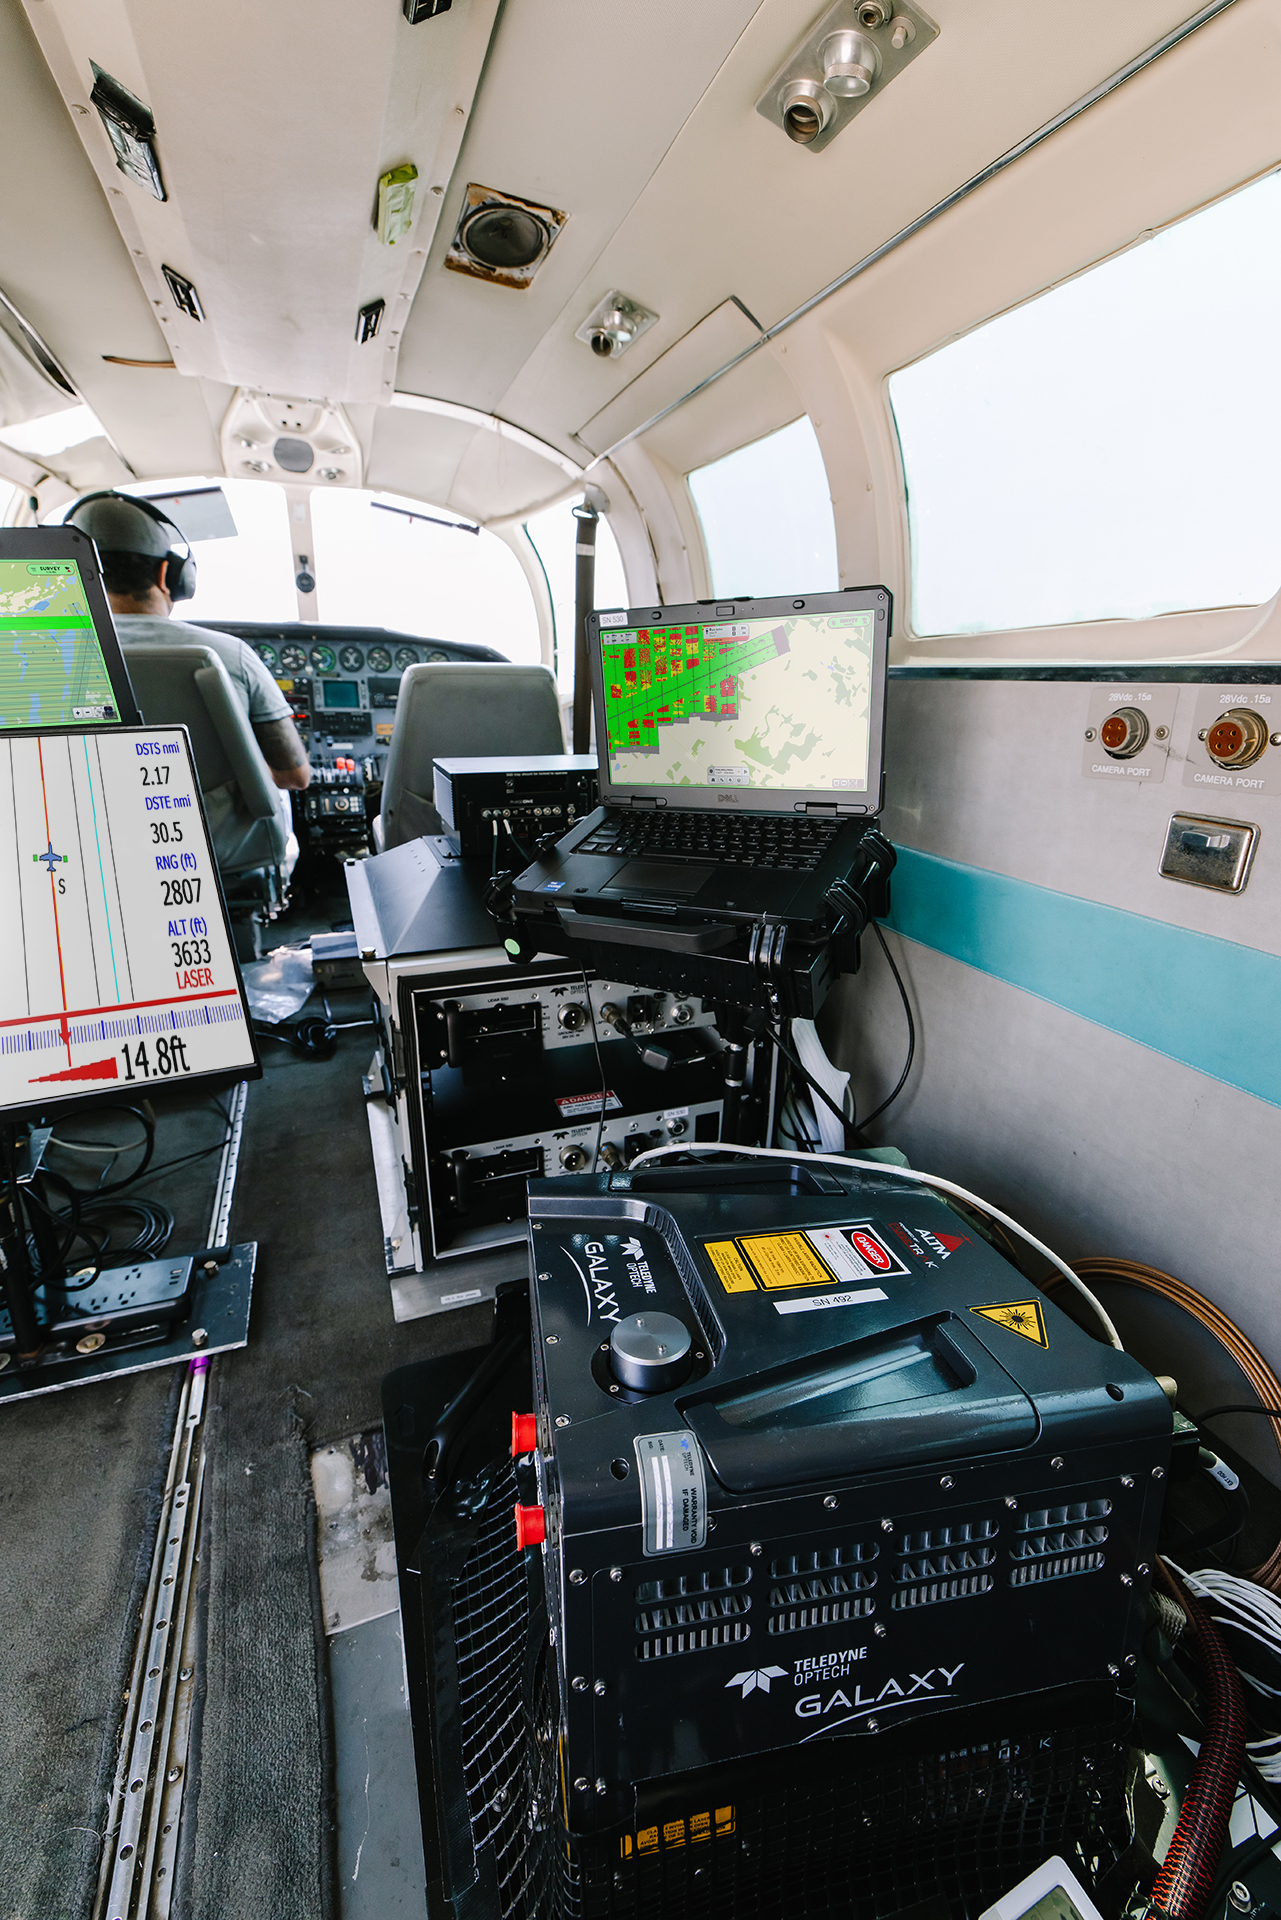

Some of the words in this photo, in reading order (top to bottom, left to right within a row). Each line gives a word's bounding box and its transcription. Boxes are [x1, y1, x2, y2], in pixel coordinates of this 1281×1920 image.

[602, 616, 612, 624] SN
[613, 615, 624, 623] 530
[1109, 693, 1133, 701] 28Vdc
[1219, 694, 1248, 704] 28Vdc
[135, 742, 161, 756] DSTS
[162, 741, 180, 754] nmi
[140, 766, 170, 786] 2.17
[1092, 764, 1125, 775] CAMERA
[1126, 767, 1151, 777] PORT
[1194, 773, 1233, 786] CAMERA
[1235, 778, 1265, 789] PORT
[145, 797, 171, 811] DSTE
[173, 796, 192, 809] nmi
[717, 794, 739, 803] DELL
[150, 821, 183, 844] 30.5
[155, 855, 179, 871] RNG
[180, 853, 198, 870] (ft)
[58, 878, 67, 895] S
[160, 878, 202, 907] 2807
[167, 920, 189, 937] ALT
[190, 917, 208, 938] (ft)
[171, 939, 212, 967] 3633
[176, 968, 215, 990] LASER
[121, 1035, 190, 1081] 14.8ft
[855, 1235, 885, 1264] DANGER
[914, 1228, 952, 1260] ALTM
[584, 1241, 623, 1324] GALAXY
[626, 1262, 643, 1288] OPTECH
[637, 1260, 657, 1294] TELEDYNE
[812, 1296, 830, 1307] SN
[832, 1294, 852, 1304] 492
[685, 1451, 695, 1476] TELEDYNE
[682, 1488, 689, 1496] IF
[682, 1498, 690, 1531] DAMAGED
[690, 1487, 698, 1527] WARRANTY
[690, 1527, 698, 1544] VOID
[793, 1646, 868, 1673] TELEDYNE
[793, 1663, 850, 1686] OPTECH
[794, 1663, 965, 1718] GALAXY
